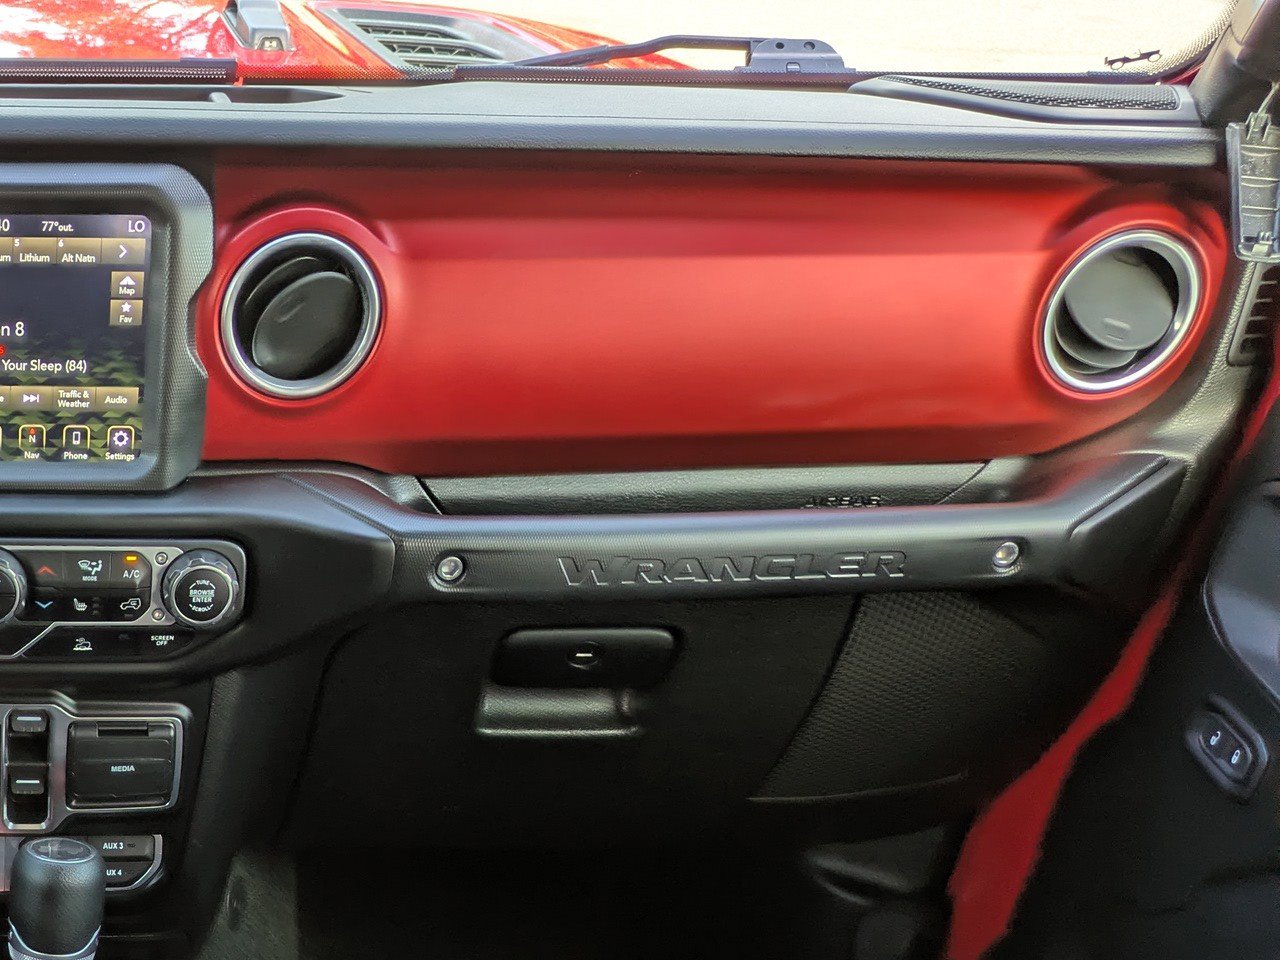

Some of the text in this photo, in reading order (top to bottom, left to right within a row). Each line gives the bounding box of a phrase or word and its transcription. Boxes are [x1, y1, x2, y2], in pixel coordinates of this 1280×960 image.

[128, 220, 145, 233] LO
[14, 239, 20, 247] 5
[58, 239, 64, 247] 6
[19, 253, 50, 263] Lithium
[61, 253, 95, 263] Alt Natn
[118, 287, 135, 296] Map
[119, 315, 133, 323] Fav
[15, 321, 25, 337] 8
[2, 359, 27, 371] Your
[30, 359, 62, 373] Sleep
[65, 359, 87, 373] (84)
[58, 390, 90, 399] Traffic &
[57, 400, 90, 408] Weather
[105, 396, 128, 404] Audio
[28, 435, 36, 443] N
[24, 451, 40, 459] Nav
[63, 451, 88, 460] Phone
[105, 452, 135, 461] Settings
[557, 550, 907, 586] WRANGLER
[123, 570, 140, 579] A/C
